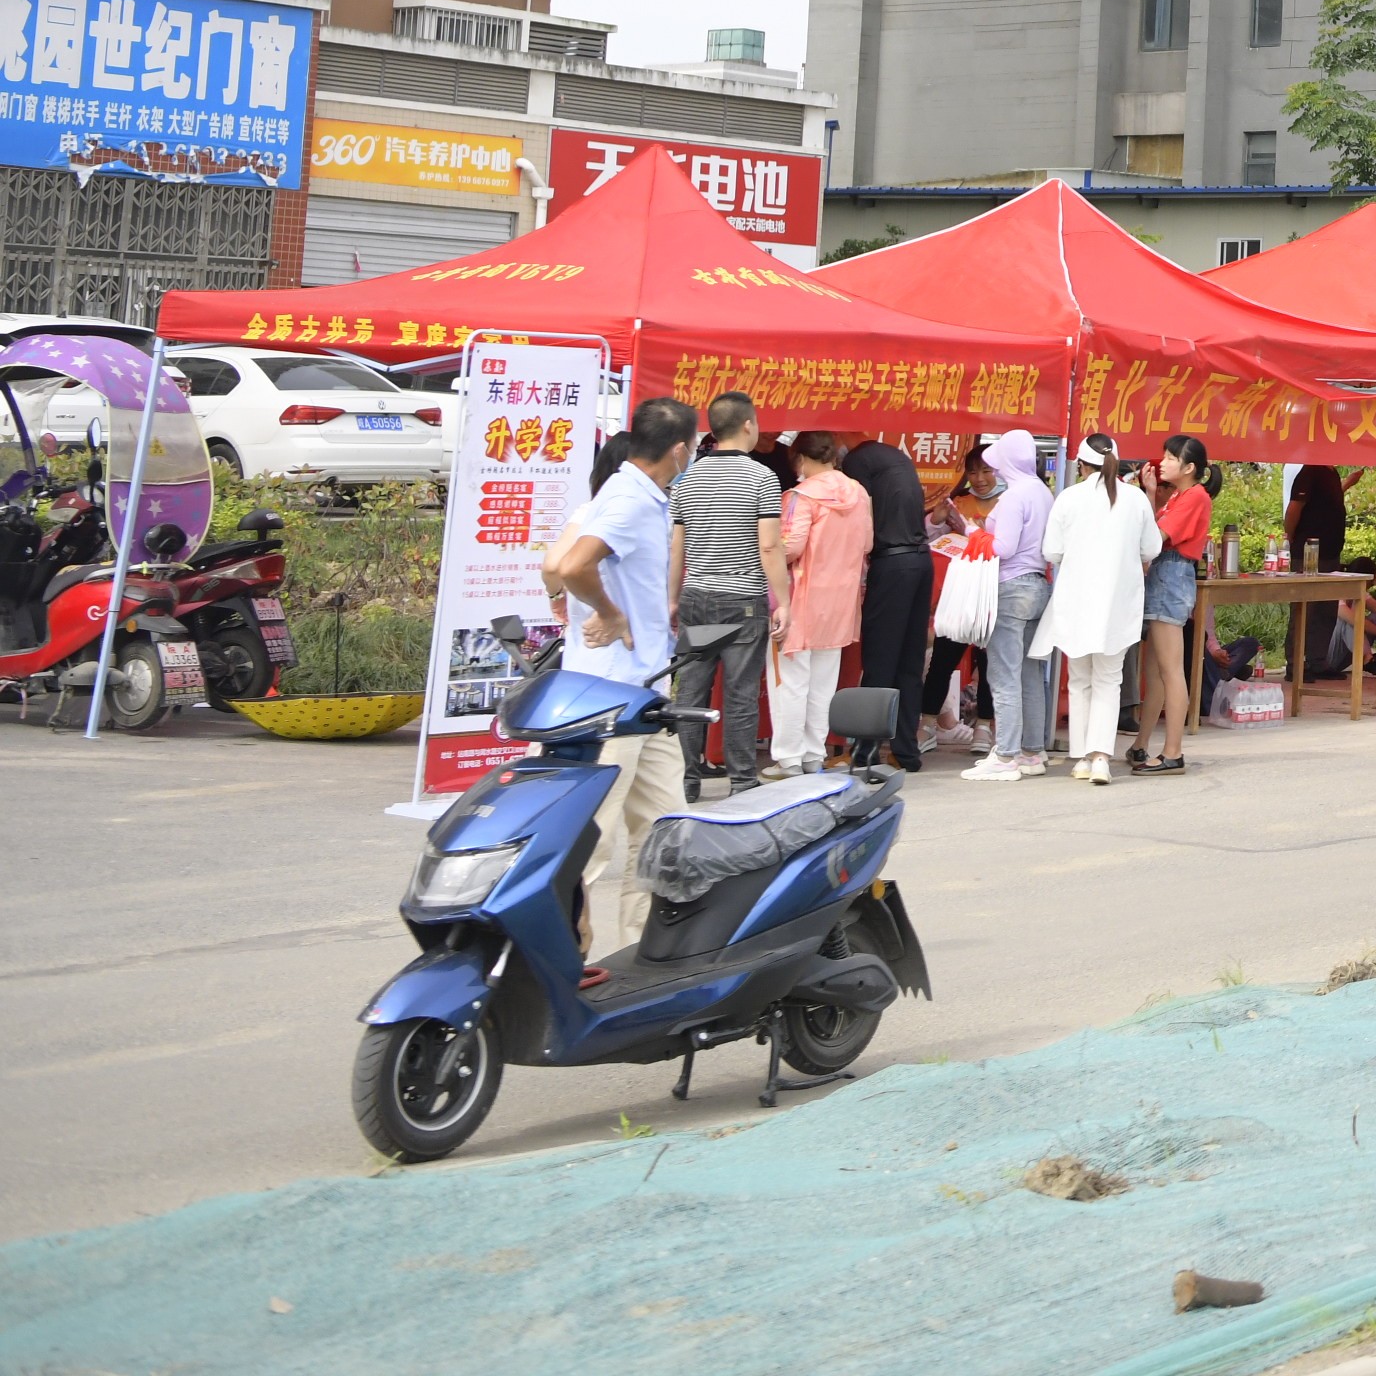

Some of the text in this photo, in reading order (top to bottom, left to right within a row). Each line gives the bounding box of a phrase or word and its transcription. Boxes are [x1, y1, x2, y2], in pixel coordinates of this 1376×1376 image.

[42, 94, 100, 128] 楼梯扶手
[104, 101, 132, 131] 栏杆
[136, 105, 164, 133] 衣架
[168, 108, 234, 140] 大型广告牌
[238, 115, 290, 146] 宣传栏等
[385, 136, 511, 173] 汽车养护中心
[583, 140, 788, 216] 天电池
[487, 378, 580, 406] 东都大酒店
[967, 362, 1041, 417] 金榜题名
[485, 416, 574, 463] 升学宴
